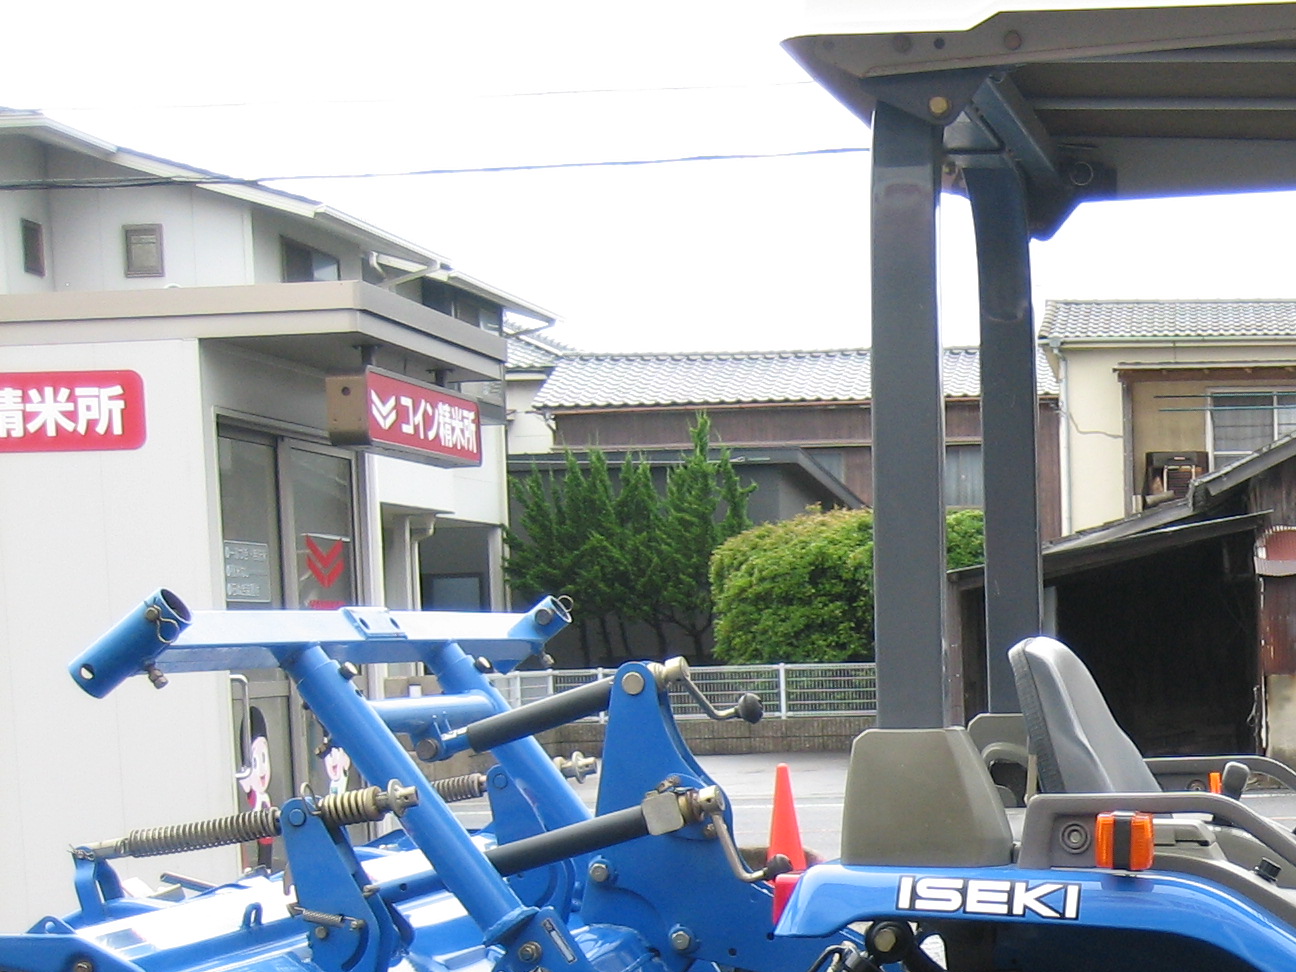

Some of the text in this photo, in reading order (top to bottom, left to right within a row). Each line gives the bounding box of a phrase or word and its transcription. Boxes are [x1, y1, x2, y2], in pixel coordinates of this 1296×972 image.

[399, 395, 478, 454] コイン精米所
[897, 875, 1082, 920] ISEKI
